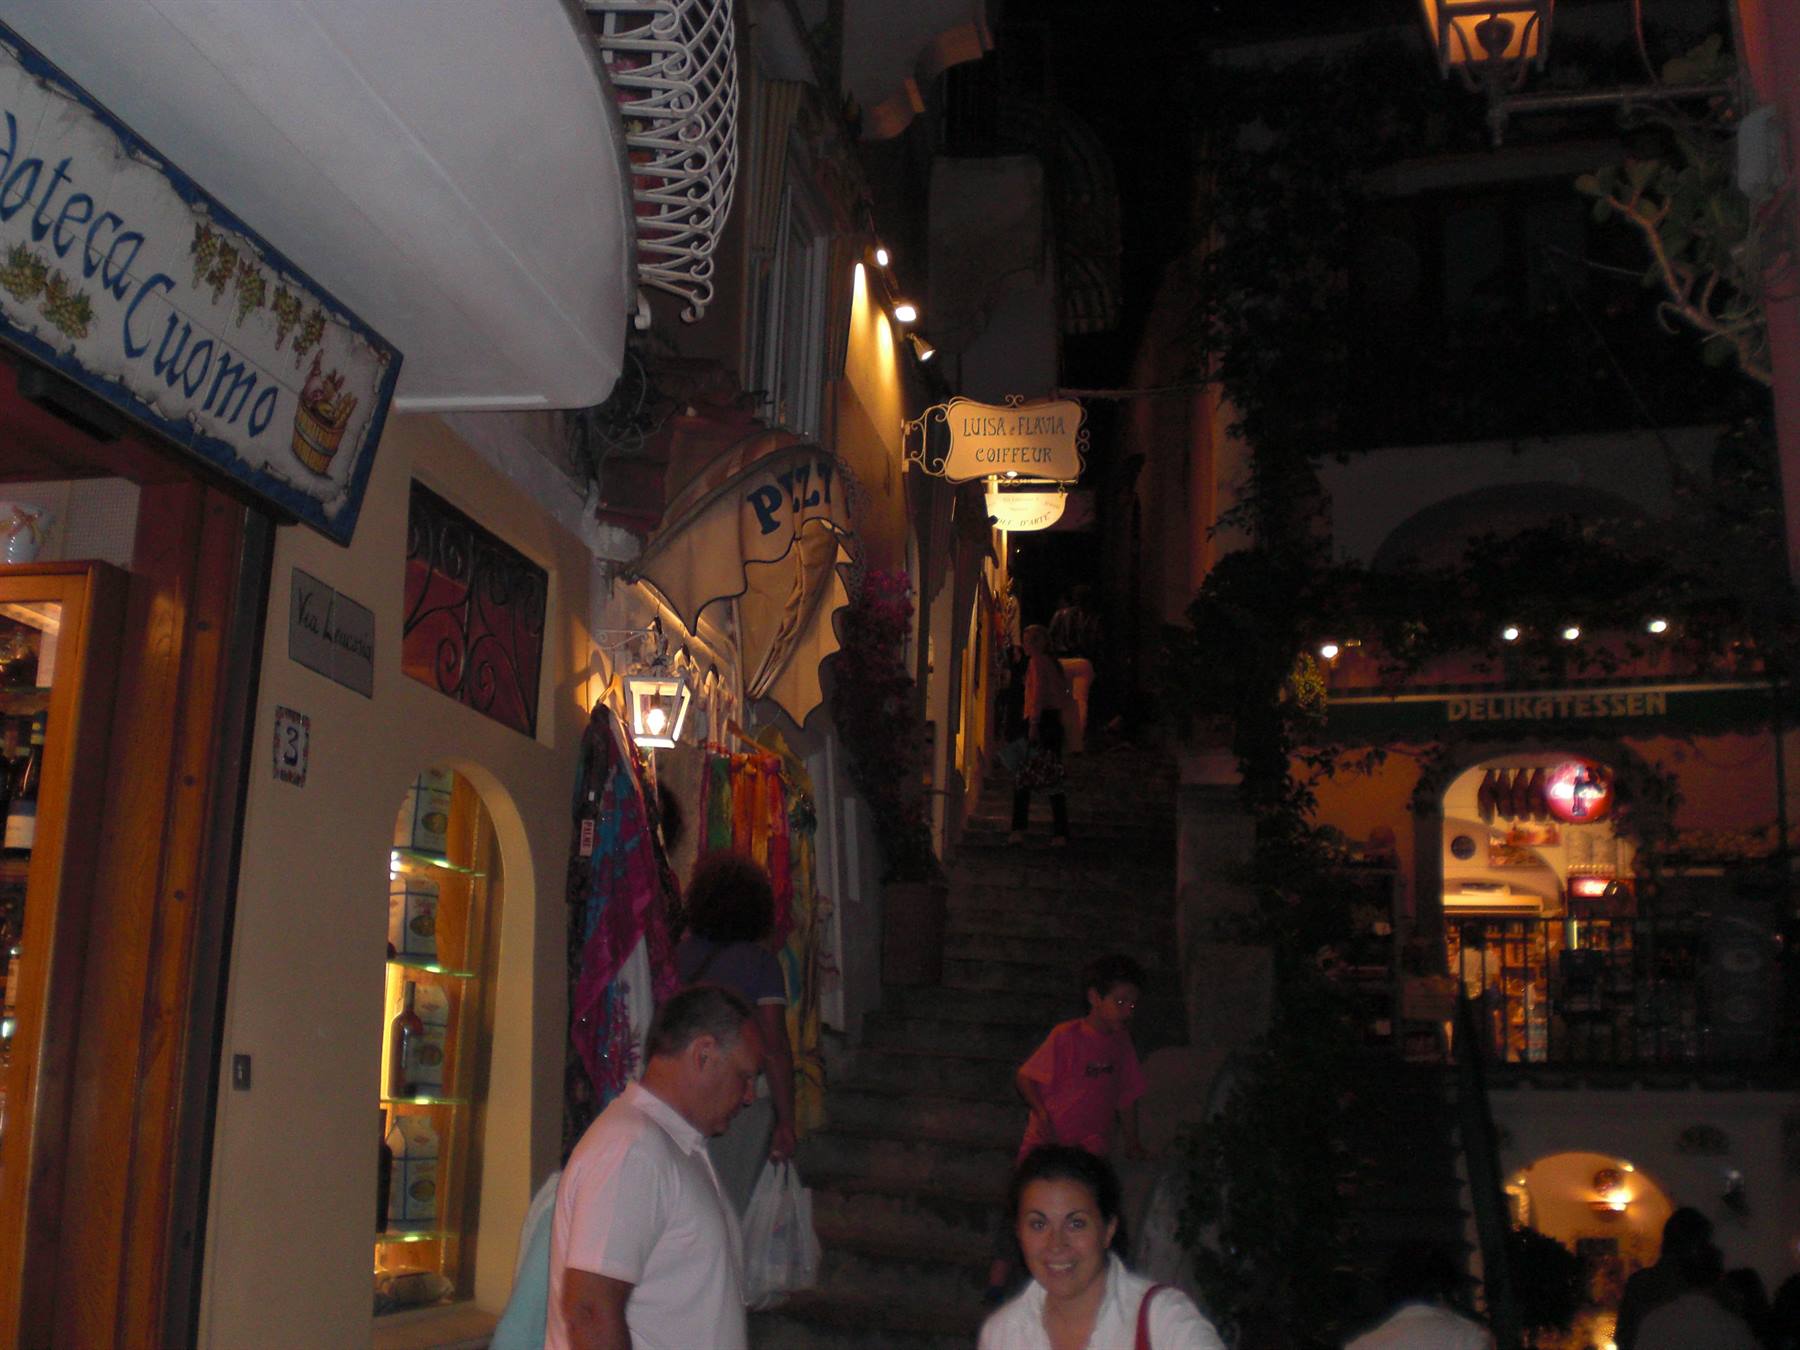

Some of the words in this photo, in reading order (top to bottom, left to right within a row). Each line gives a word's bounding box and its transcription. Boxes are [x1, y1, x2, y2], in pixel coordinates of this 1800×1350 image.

[124, 272, 280, 438] Cuomo
[963, 416, 1006, 437] LUISA
[1018, 415, 1066, 436] FLAVIA
[975, 446, 1053, 464] COIFFEUR
[1448, 691, 1667, 722] DELIKATESSEN
